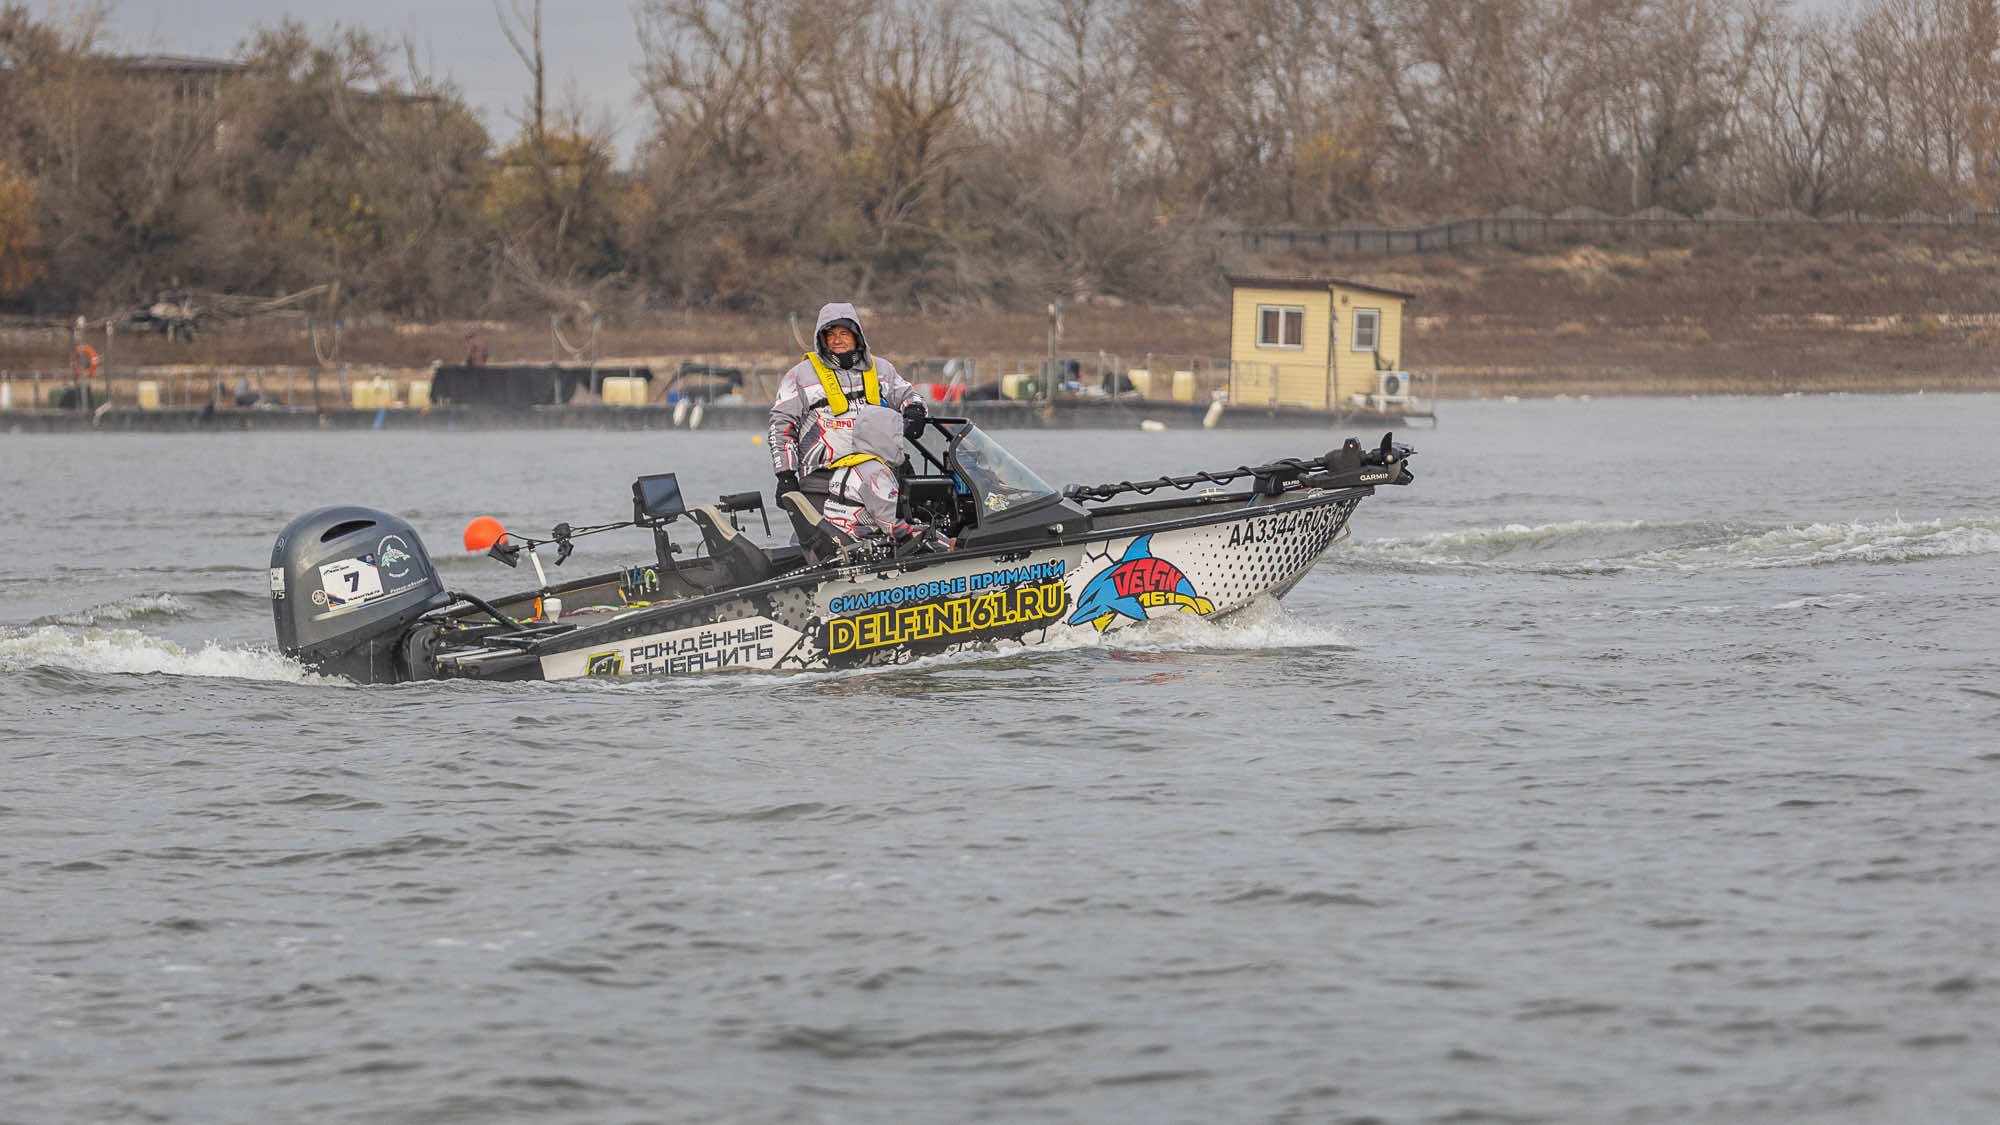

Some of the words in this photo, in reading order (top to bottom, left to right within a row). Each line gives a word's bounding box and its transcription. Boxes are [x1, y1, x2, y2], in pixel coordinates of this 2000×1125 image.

[343, 571, 360, 593] 7
[829, 577, 967, 614] СИЛИКОНОВЫЕ
[970, 559, 1066, 592] ПРИМАНКИ
[1138, 590, 1176, 608] 161
[828, 582, 1066, 655] DELFIN161.RU
[629, 623, 774, 663] РОЖДЁННЫЕ
